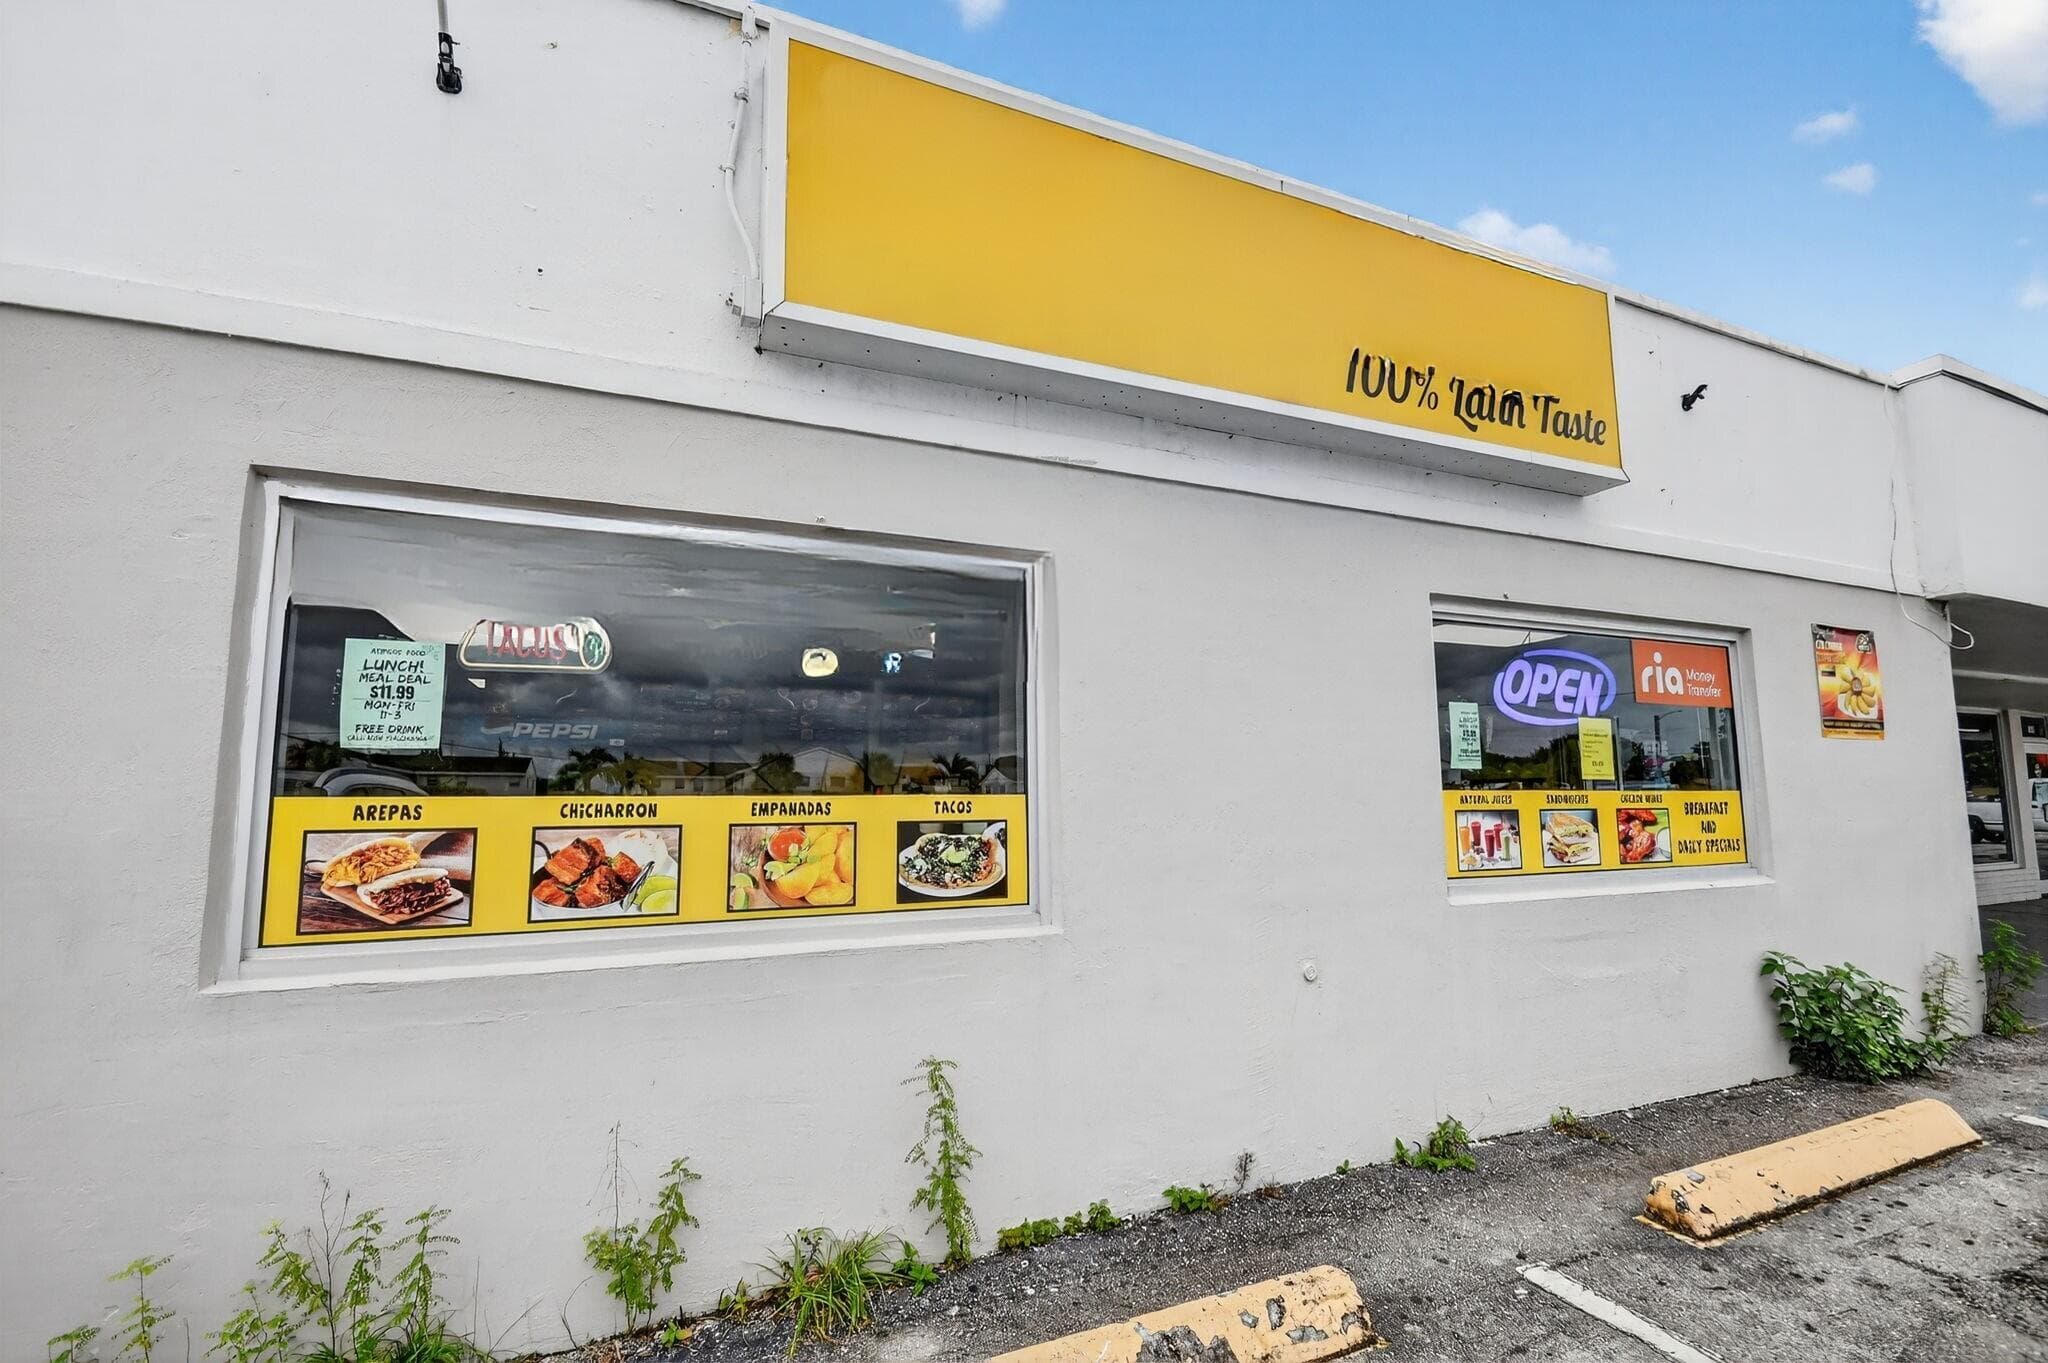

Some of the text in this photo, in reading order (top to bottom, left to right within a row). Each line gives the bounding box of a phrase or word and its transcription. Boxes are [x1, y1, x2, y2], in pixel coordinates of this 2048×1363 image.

[1346, 347, 1439, 410] 100%
[1533, 394, 1608, 445] Taste
[363, 659, 424, 674] LUNCH!
[1641, 651, 1715, 696] ria Money
[359, 672, 431, 684] MEAL DEAL
[370, 685, 415, 699] $11.99
[1502, 658, 1605, 717] OPEN
[1687, 683, 1722, 698] Transfer
[364, 700, 415, 711] MON-FRI
[355, 724, 424, 735] FREE DRINK
[512, 722, 599, 739] PEPSI
[353, 804, 423, 821] AREPAS
[751, 802, 831, 817] EMPANADAS
[934, 801, 972, 814] TACOS
[1684, 802, 1728, 816] BREAKFAST
